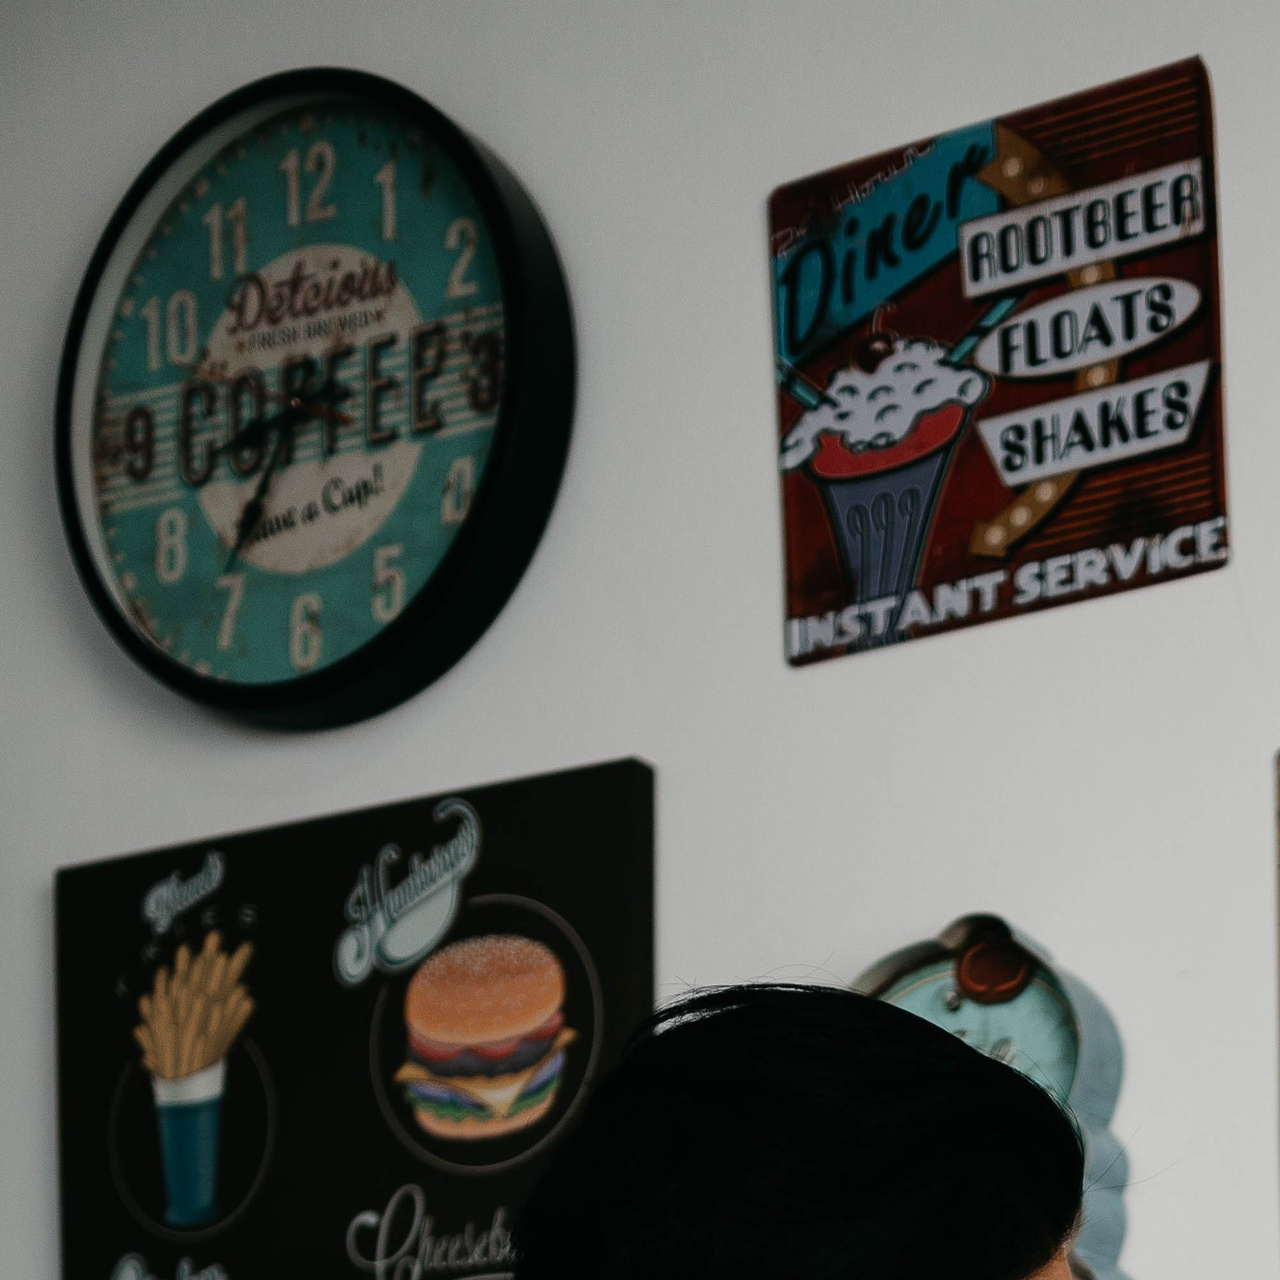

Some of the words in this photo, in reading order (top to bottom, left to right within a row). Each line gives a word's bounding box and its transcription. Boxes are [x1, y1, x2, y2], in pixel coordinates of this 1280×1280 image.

[278, 140, 337, 227] 12
[374, 160, 398, 241] 1
[202, 196, 248, 281] 11
[444, 214, 480, 299] 2
[778, 143, 988, 356] Diner
[968, 172, 1202, 284] ROOTBEER
[141, 289, 198, 371] 10
[1000, 283, 1176, 374] FLOATS
[127, 406, 154, 480] 9
[1000, 380, 1192, 478] SHAKES
[156, 506, 188, 584] 8
[372, 544, 406, 625] 5
[216, 571, 246, 650] 7
[785, 569, 1008, 661] INSTANT
[1012, 515, 1229, 607] SERVICE
[288, 593, 323, 672] 6
